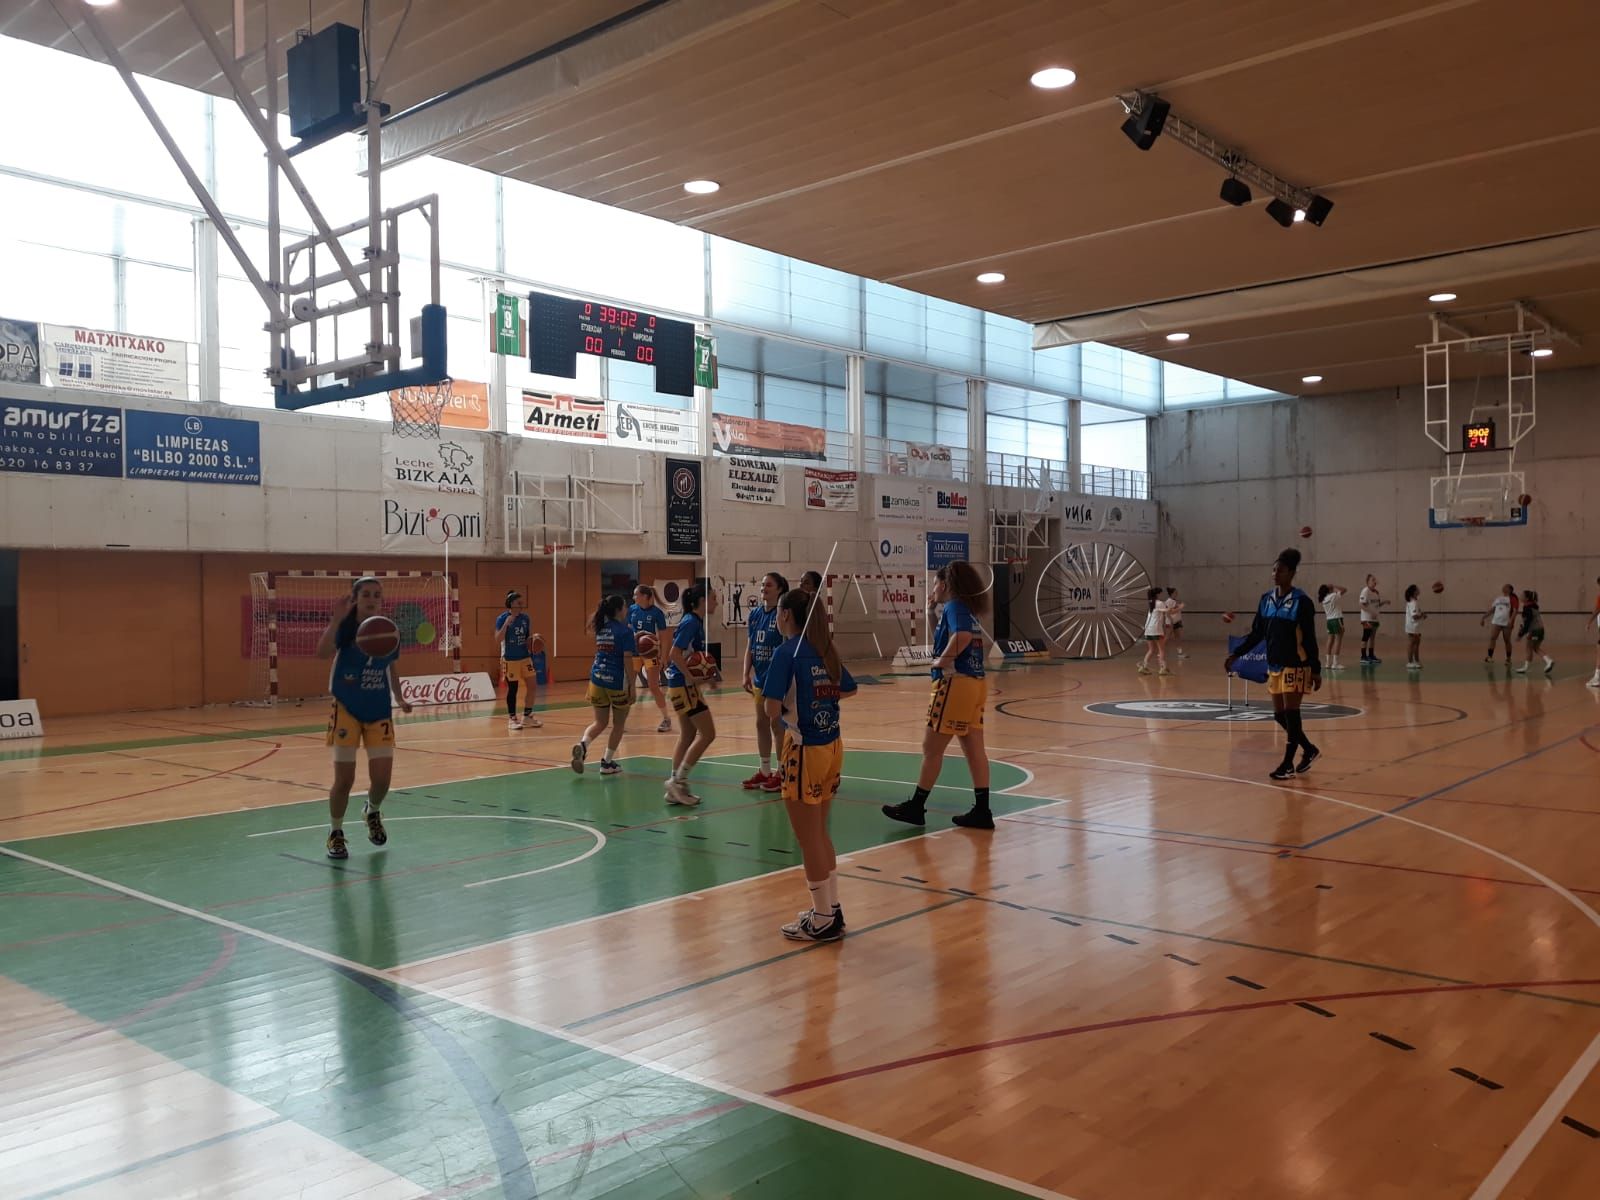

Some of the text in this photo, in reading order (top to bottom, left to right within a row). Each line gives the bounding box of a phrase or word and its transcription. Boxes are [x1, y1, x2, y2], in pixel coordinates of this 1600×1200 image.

[599, 306, 638, 328] 39:02
[74, 330, 165, 353] MATXITXAKO
[585, 336, 603, 353] 00
[636, 345, 654, 362] 00
[3, 406, 121, 434] amuriza
[187, 421, 200, 431] LB
[527, 406, 601, 431] Armeti
[3, 429, 121, 445] inmobiliaria
[156, 434, 229, 452] LIMPIEZAS
[1470, 436, 1488, 448] 24
[59, 447, 117, 459] Galdakao
[188, 453, 218, 467] 2000
[33, 459, 49, 469] 16
[55, 460, 72, 470] 83
[78, 462, 94, 472] 37
[395, 457, 434, 469] Leche
[729, 457, 777, 472] SIDRERIA
[130, 467, 180, 477] LIMPIEZAS
[188, 471, 259, 482] MANTENIMIENTO
[395, 467, 473, 486] BIZKAIA
[728, 469, 779, 485] ELEXALDE
[936, 490, 968, 506] BigMat
[755, 629, 766, 643] 10
[1007, 639, 1035, 653] DEIA
[1284, 672, 1294, 684] 15
